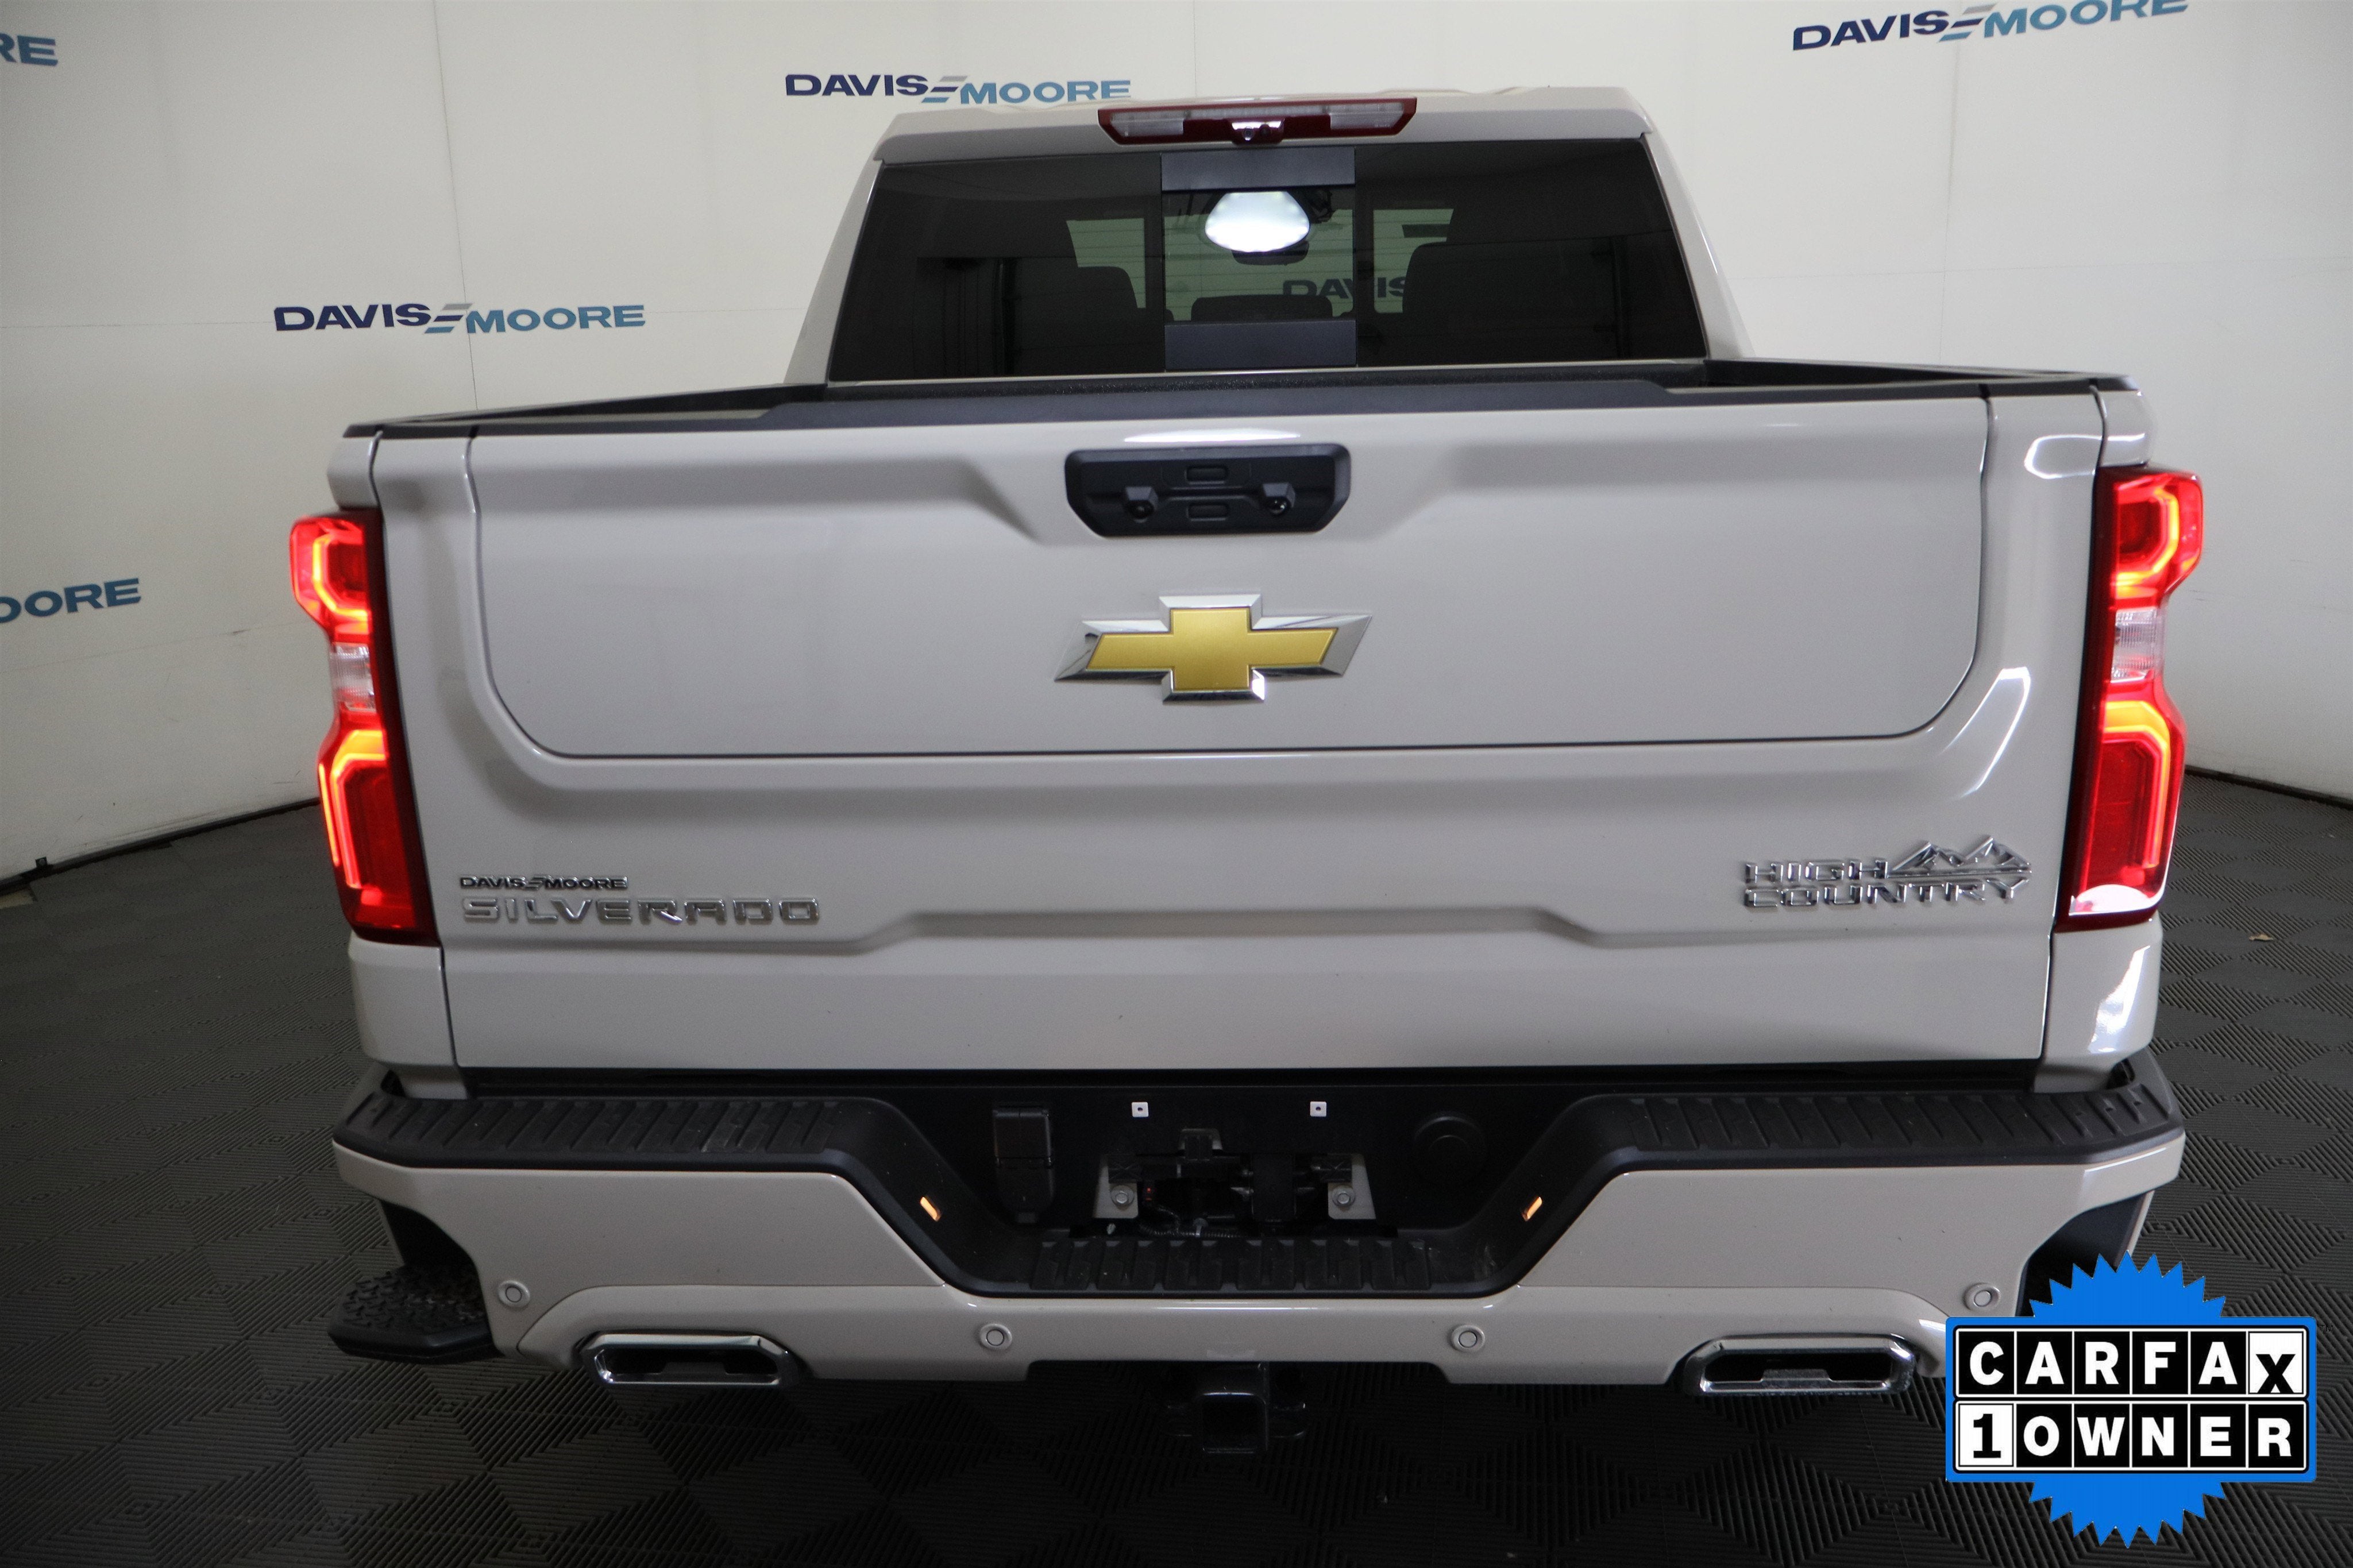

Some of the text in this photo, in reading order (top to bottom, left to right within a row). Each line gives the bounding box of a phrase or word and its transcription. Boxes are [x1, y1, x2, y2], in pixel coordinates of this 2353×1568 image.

[1793, 10, 1950, 51] DAVIS
[785, 74, 1131, 105] DAVIS MOORE
[1282, 276, 1407, 299] DAIS
[273, 303, 646, 334] DAVIS MOORE
[460, 876, 628, 890] DAVIS MOORE
[1744, 859, 1889, 883] HIGH
[1743, 877, 2030, 907] COUNTRY
[461, 897, 821, 925] SILVERADO
